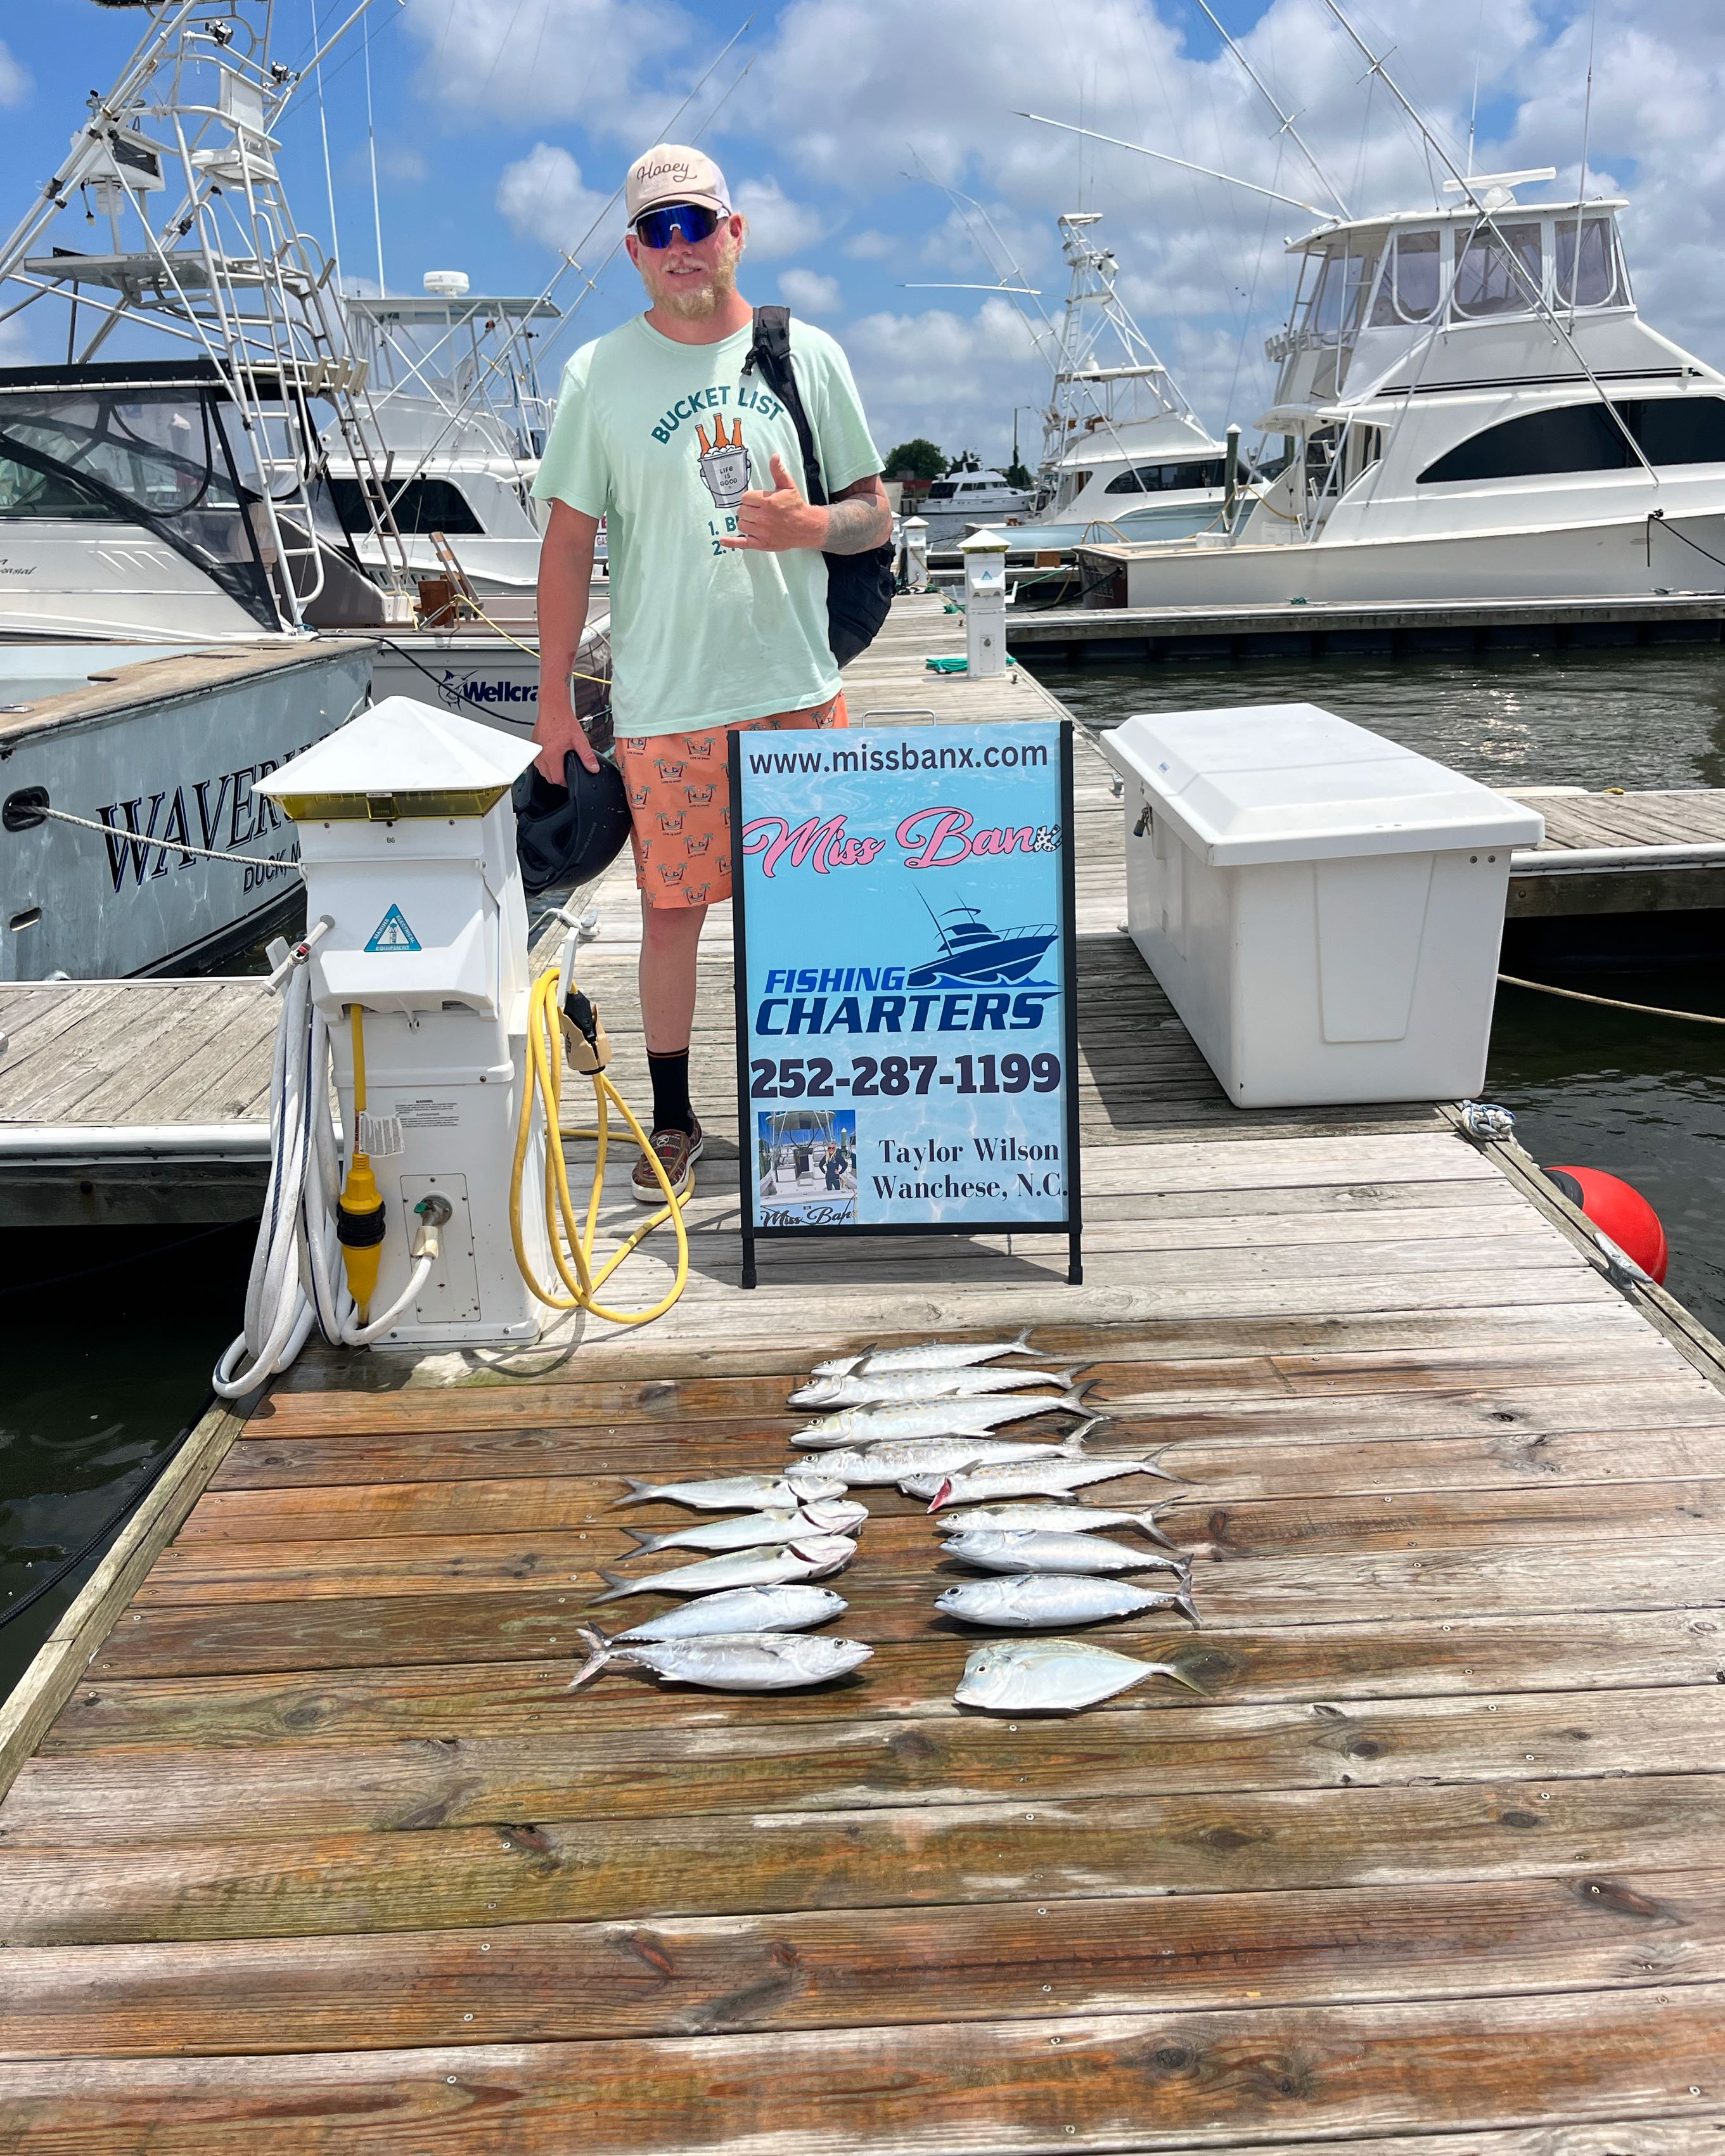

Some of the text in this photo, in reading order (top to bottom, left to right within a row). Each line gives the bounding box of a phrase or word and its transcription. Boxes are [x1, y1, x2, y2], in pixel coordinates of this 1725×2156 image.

[637, 162, 698, 183] Hooey
[651, 385, 784, 444] BUCKET LIST
[720, 478, 738, 487] GOOD
[709, 520, 719, 536] 1.
[712, 540, 727, 556] 2.
[463, 681, 539, 702] Wellcra
[749, 742, 1048, 774] www.missbanx.com
[743, 806, 1062, 878] Miss Banx
[764, 966, 906, 993] FISHING
[755, 991, 1064, 1036] CHARTERS
[750, 1053, 1061, 1098] 252-287-1199
[878, 1137, 1060, 1171] Taylor Wilson
[871, 1172, 1068, 1202] Wanchese, N.C.
